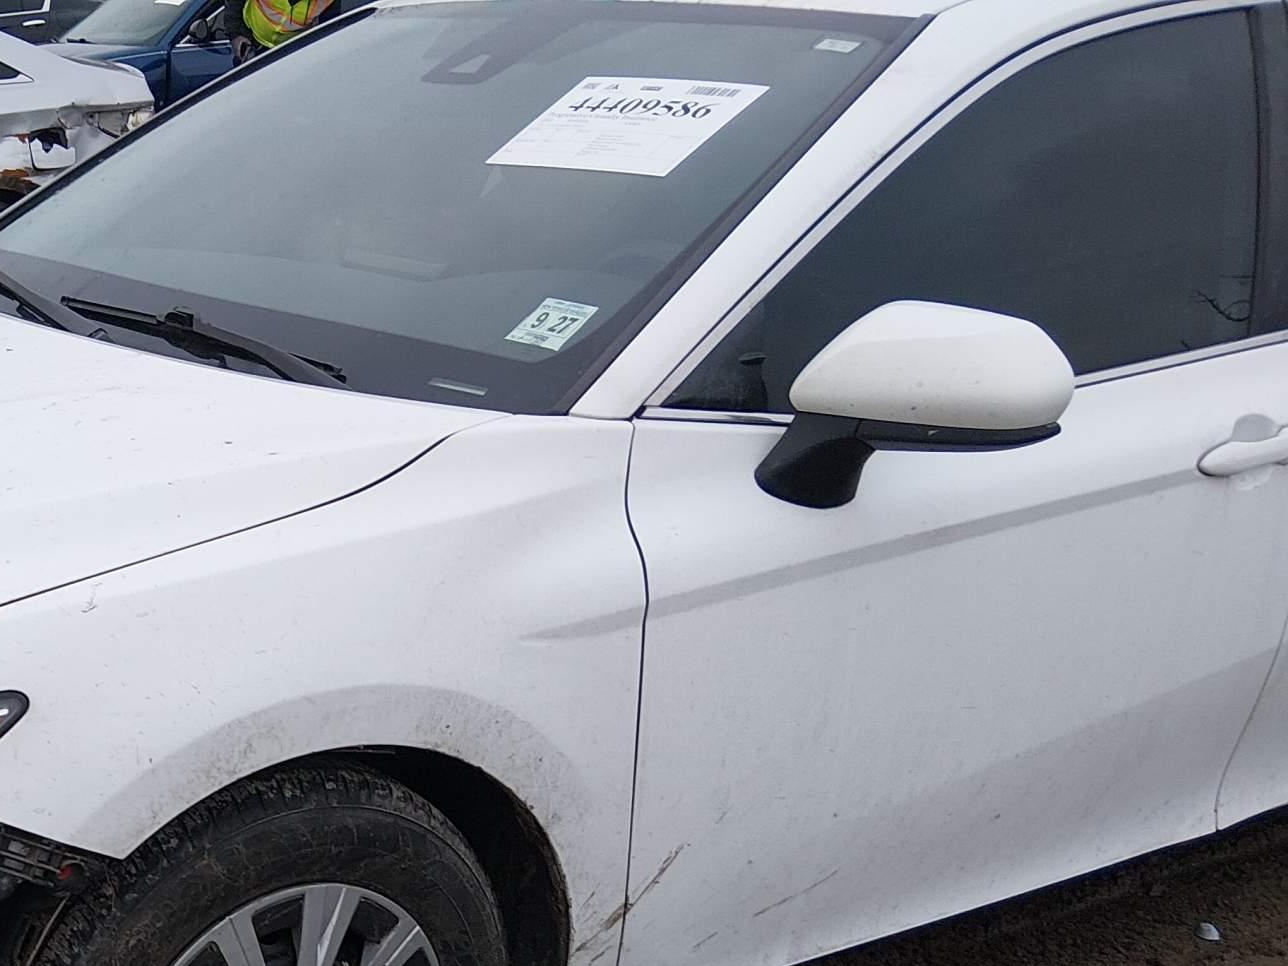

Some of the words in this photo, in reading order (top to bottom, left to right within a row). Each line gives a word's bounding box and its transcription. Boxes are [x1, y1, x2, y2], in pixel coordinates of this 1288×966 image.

[568, 96, 720, 119] 44409586
[531, 311, 550, 329] 9
[547, 315, 579, 335] 27
